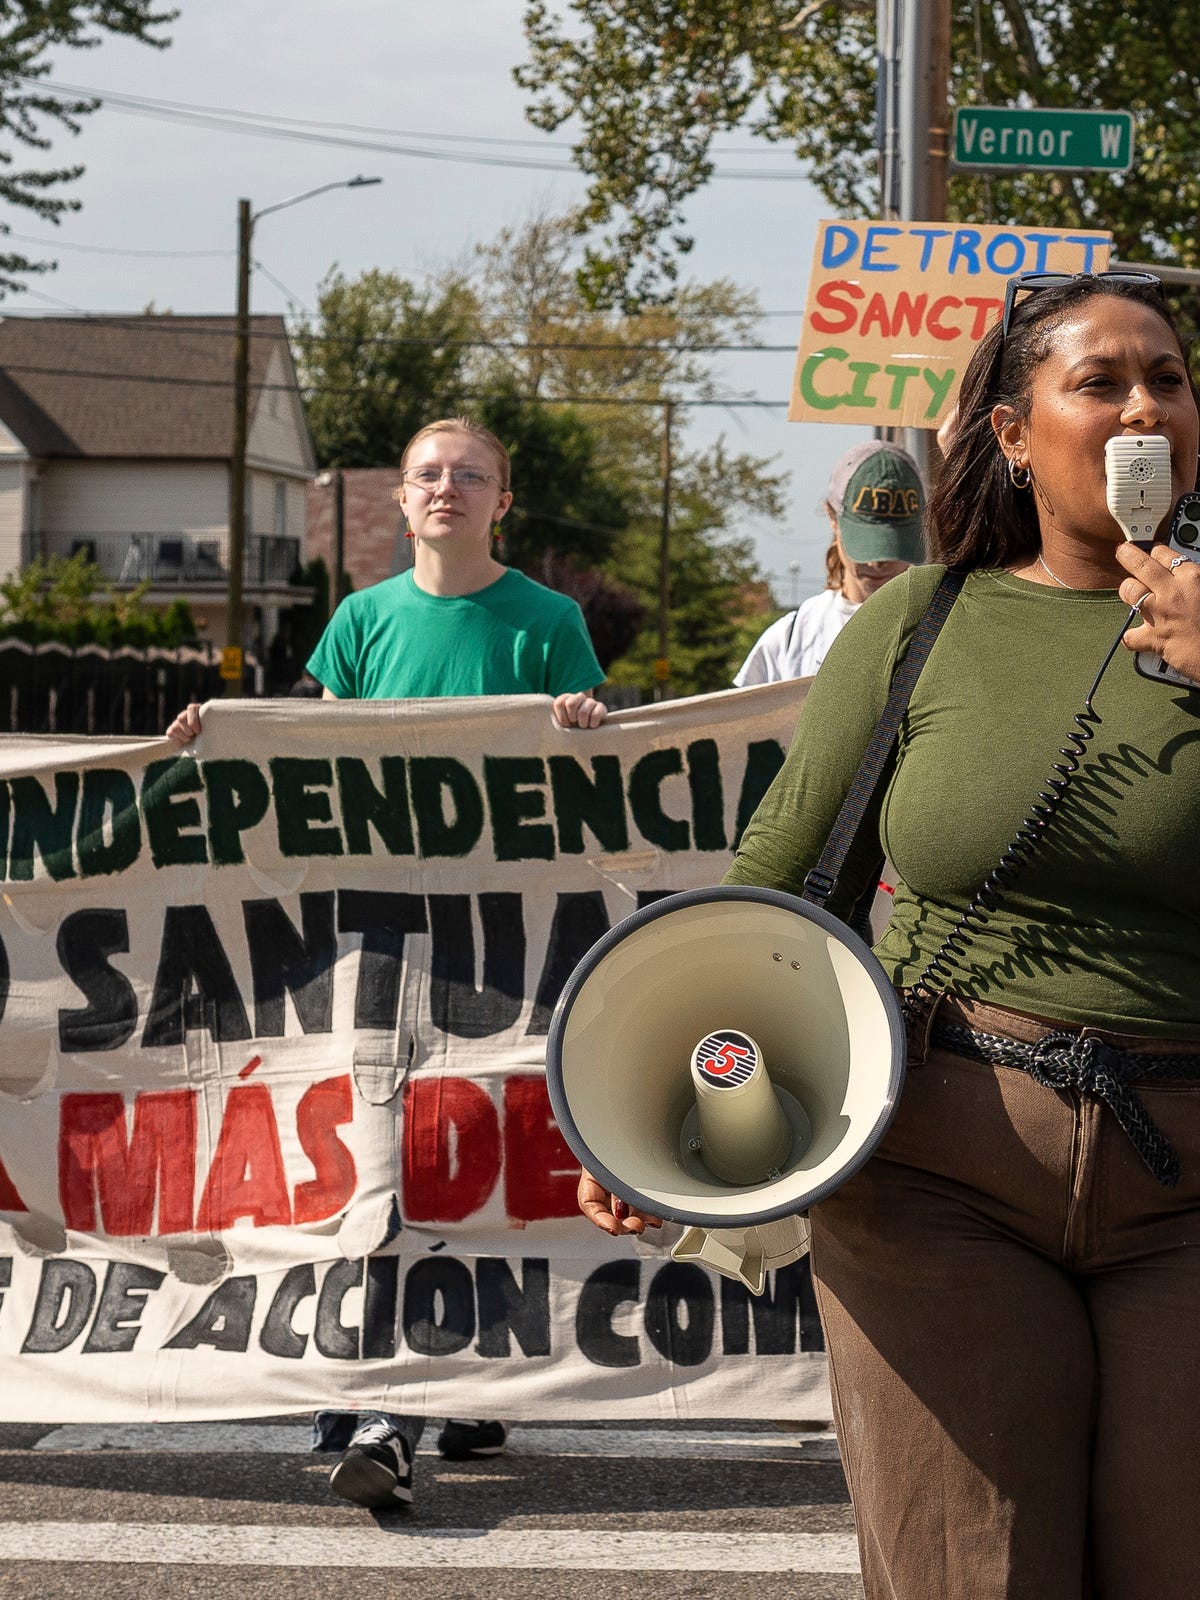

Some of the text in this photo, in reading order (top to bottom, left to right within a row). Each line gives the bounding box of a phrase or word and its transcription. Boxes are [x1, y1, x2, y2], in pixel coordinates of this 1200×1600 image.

[961, 118, 1123, 159] Vernor W
[820, 225, 1112, 276] DETROIT
[809, 279, 1004, 342] SANCT
[800, 347, 956, 419] CITY
[57, 889, 690, 1053] SANTUA
[703, 1040, 751, 1077] 5
[58, 1055, 360, 1236] MÁS
[20, 1257, 167, 1354] DE
[161, 1240, 553, 1360] ACCIÓN
